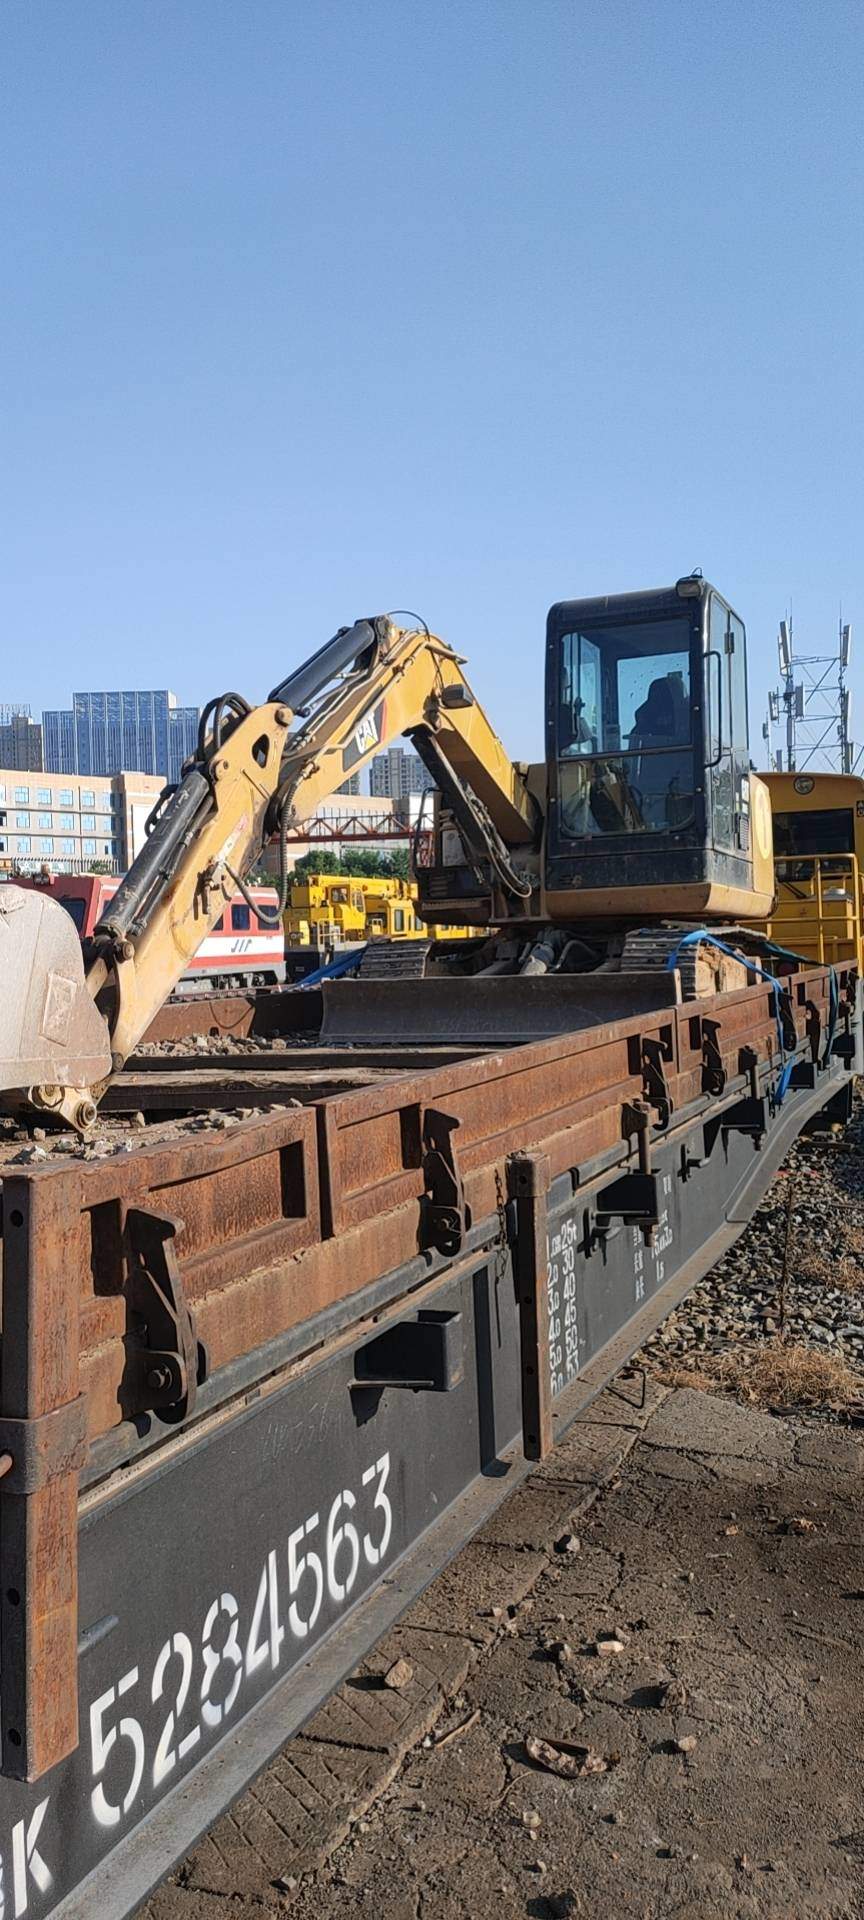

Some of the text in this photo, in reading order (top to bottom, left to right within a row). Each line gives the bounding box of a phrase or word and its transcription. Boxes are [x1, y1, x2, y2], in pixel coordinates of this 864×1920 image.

[355, 711, 378, 754] CAT
[561, 1218, 577, 1250] 25t
[562, 1246, 575, 1276] 30
[563, 1271, 576, 1301] 40
[564, 1297, 577, 1327] 45
[565, 1324, 578, 1357] 50
[0, 1795, 54, 1919] K
[90, 1451, 393, 1827] 5284563
